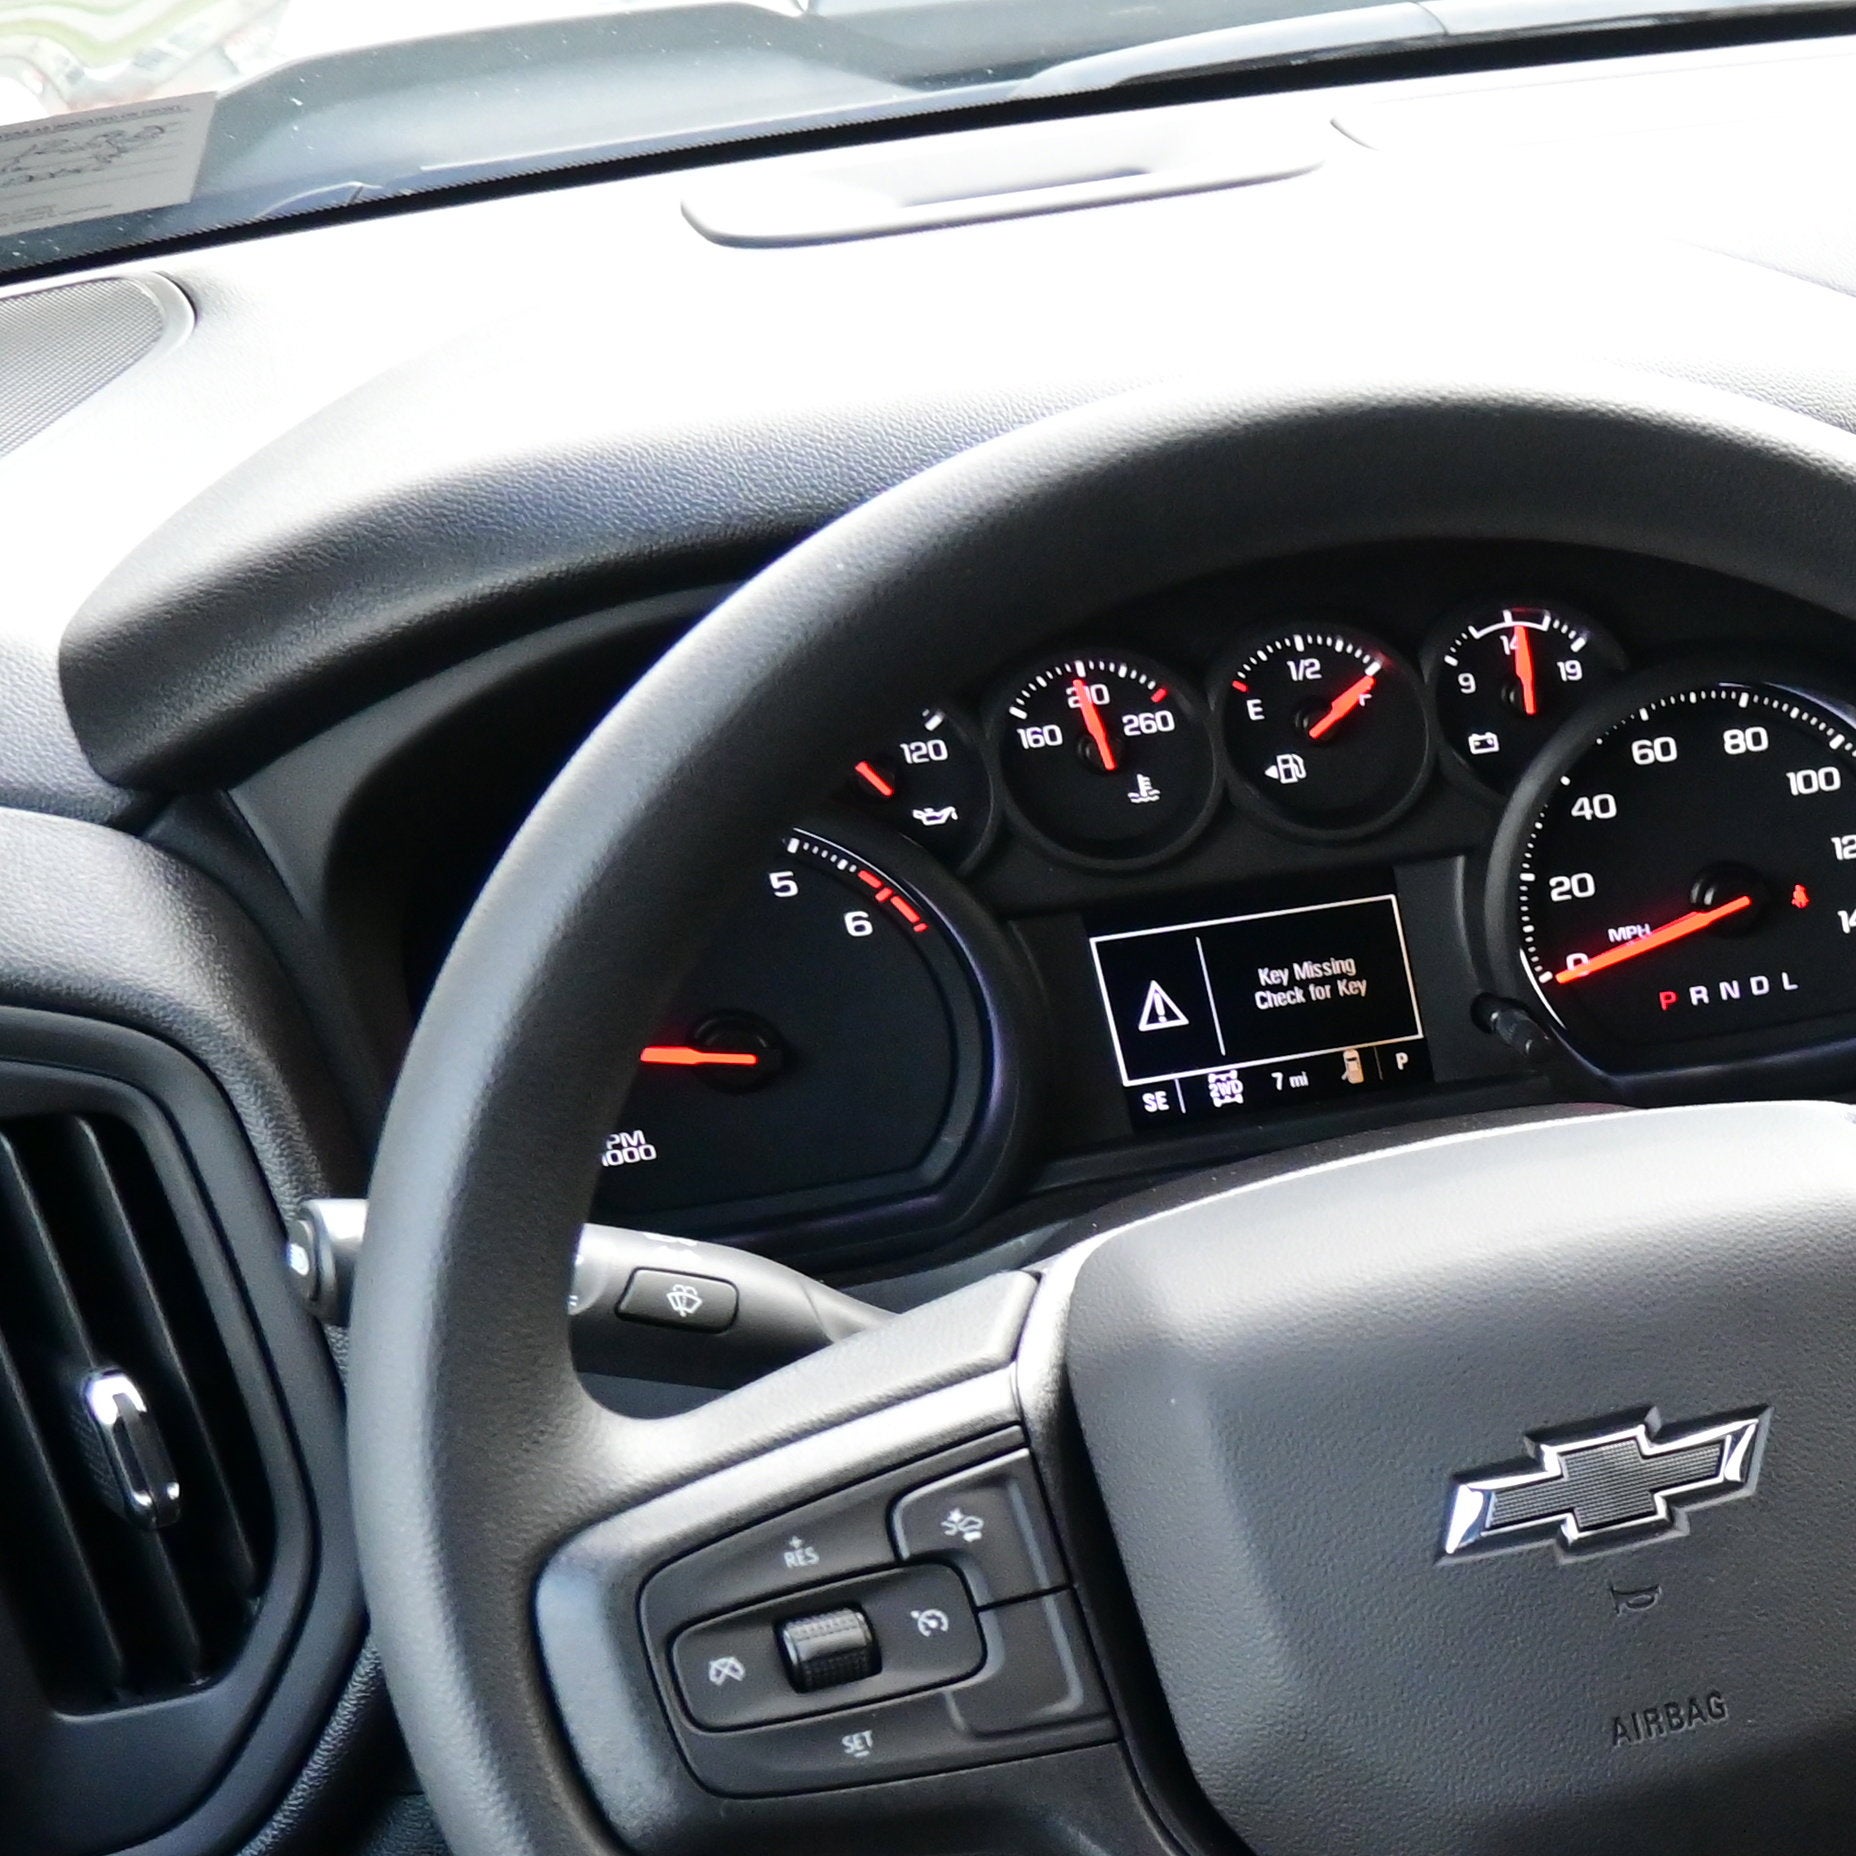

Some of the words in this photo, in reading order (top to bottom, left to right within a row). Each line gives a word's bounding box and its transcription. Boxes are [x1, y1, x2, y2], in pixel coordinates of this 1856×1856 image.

[1287, 658, 1322, 681] 1/2
[1557, 660, 1583, 681] 19
[1457, 673, 1476, 694] 9
[1247, 699, 1265, 720] E
[1122, 710, 1175, 736] 260
[1017, 724, 1063, 749] 160
[1724, 726, 1769, 754] 80
[901, 738, 949, 765] 120
[1632, 736, 1678, 764] 60
[1787, 766, 1841, 795] 100
[1571, 793, 1617, 820] 40
[768, 872, 799, 898] 5
[1550, 873, 1596, 901] 20
[844, 911, 874, 938] 6
[1607, 923, 1651, 943] MPH
[1258, 967, 1289, 987] Key
[1293, 957, 1357, 981] Missing
[1254, 987, 1306, 1010] Check
[1309, 982, 1332, 1000] for
[1337, 978, 1368, 999] Key
[1659, 991, 1677, 1011] P
[1689, 985, 1709, 1005] R
[1719, 980, 1740, 1000] N
[1750, 975, 1769, 995] D
[1782, 972, 1798, 991] L
[1395, 1052, 1409, 1070] P
[1208, 1079, 1244, 1097] 2WD
[1271, 1073, 1284, 1090] 7
[1290, 1071, 1309, 1088] mi
[1142, 1091, 1170, 1113] SE
[606, 1129, 646, 1150] PM
[783, 1547, 819, 1569] RES
[1610, 1691, 1728, 1747] AIRBAG
[841, 1729, 873, 1752] SET
